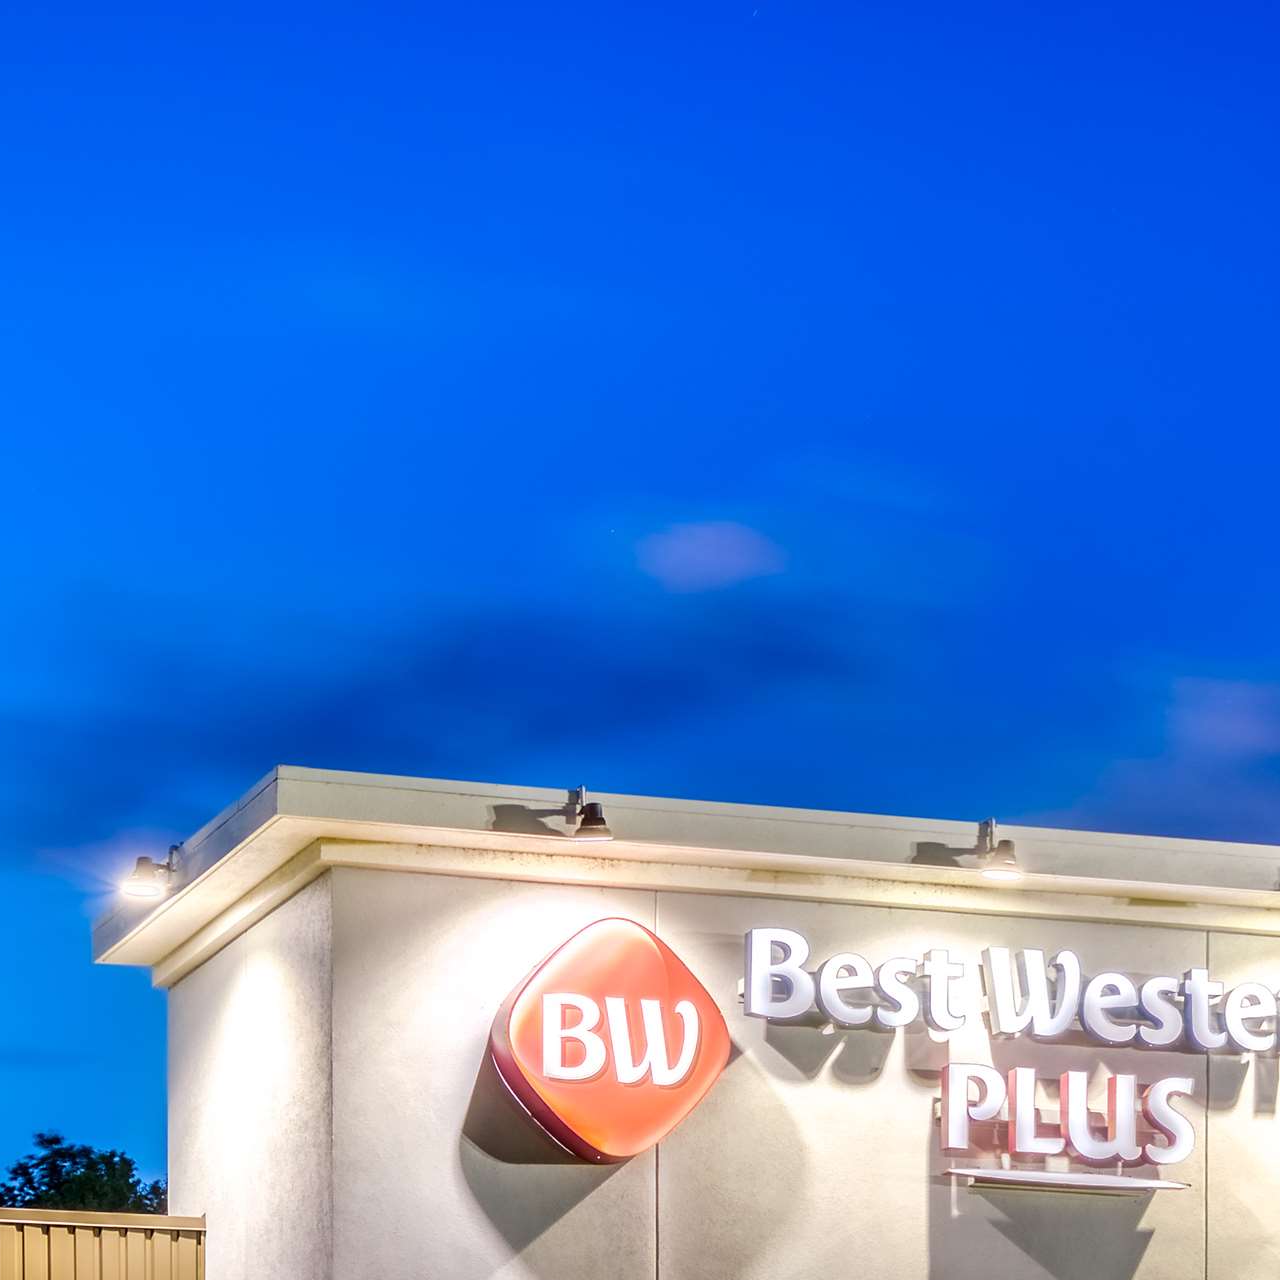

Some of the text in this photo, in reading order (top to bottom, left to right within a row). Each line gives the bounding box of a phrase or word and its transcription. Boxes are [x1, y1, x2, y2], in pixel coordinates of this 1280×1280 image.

[743, 927, 967, 1032] Best
[542, 992, 700, 1086] BW
[941, 1062, 1196, 1165] PLUS
